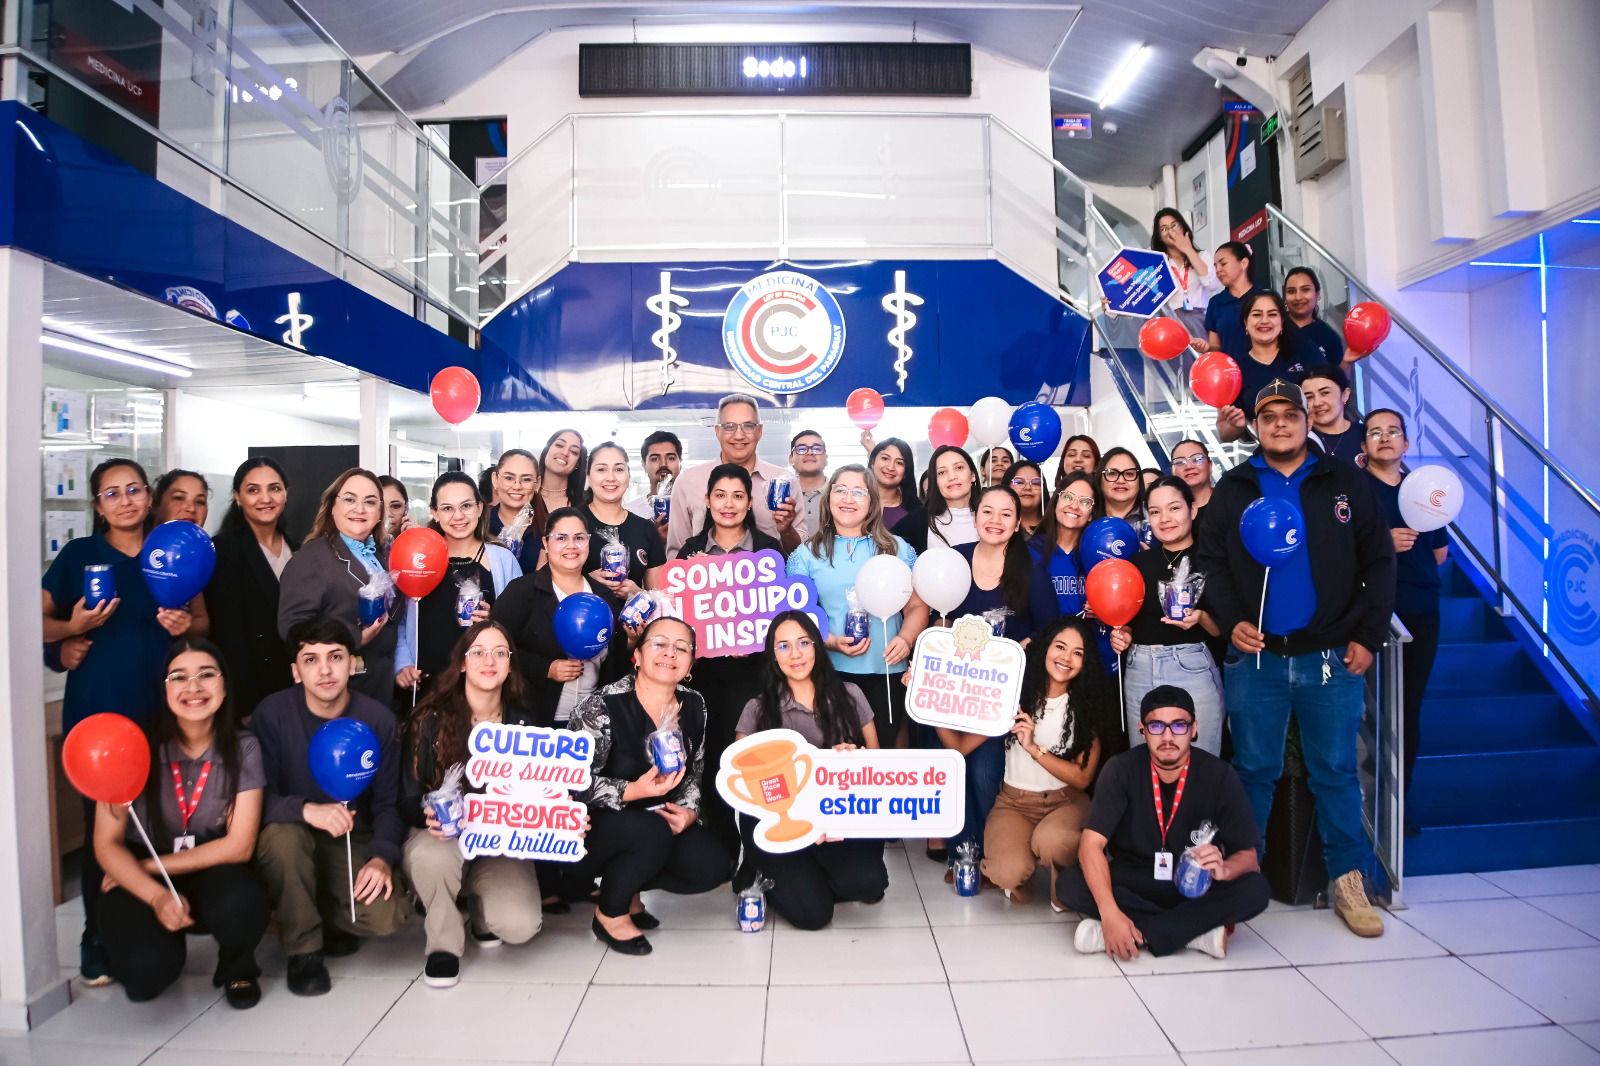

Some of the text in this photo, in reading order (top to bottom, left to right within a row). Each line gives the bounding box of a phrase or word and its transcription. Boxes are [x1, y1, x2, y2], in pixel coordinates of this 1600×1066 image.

[88, 56, 143, 96] MEDICINA UCP
[771, 326, 798, 337] PJC
[762, 376, 805, 390] CENTRAL
[804, 366, 823, 385] DEL
[819, 324, 841, 372] PARAGUAY
[667, 556, 777, 594] SOMOS
[1566, 580, 1587, 593] PJC
[694, 582, 809, 620] EQUIPO
[922, 672, 1002, 699] Nos hace
[946, 660, 1009, 684] talento
[914, 687, 1003, 721] GRANDES
[474, 728, 589, 761] CULTURA
[471, 759, 586, 785] que suma
[761, 777, 779, 786] Great
[815, 766, 947, 791] Orgullosos de
[763, 783, 781, 791] Place
[467, 799, 582, 831] PERSONAS
[819, 790, 942, 820] estar aquí
[464, 830, 580, 856] que brillan
